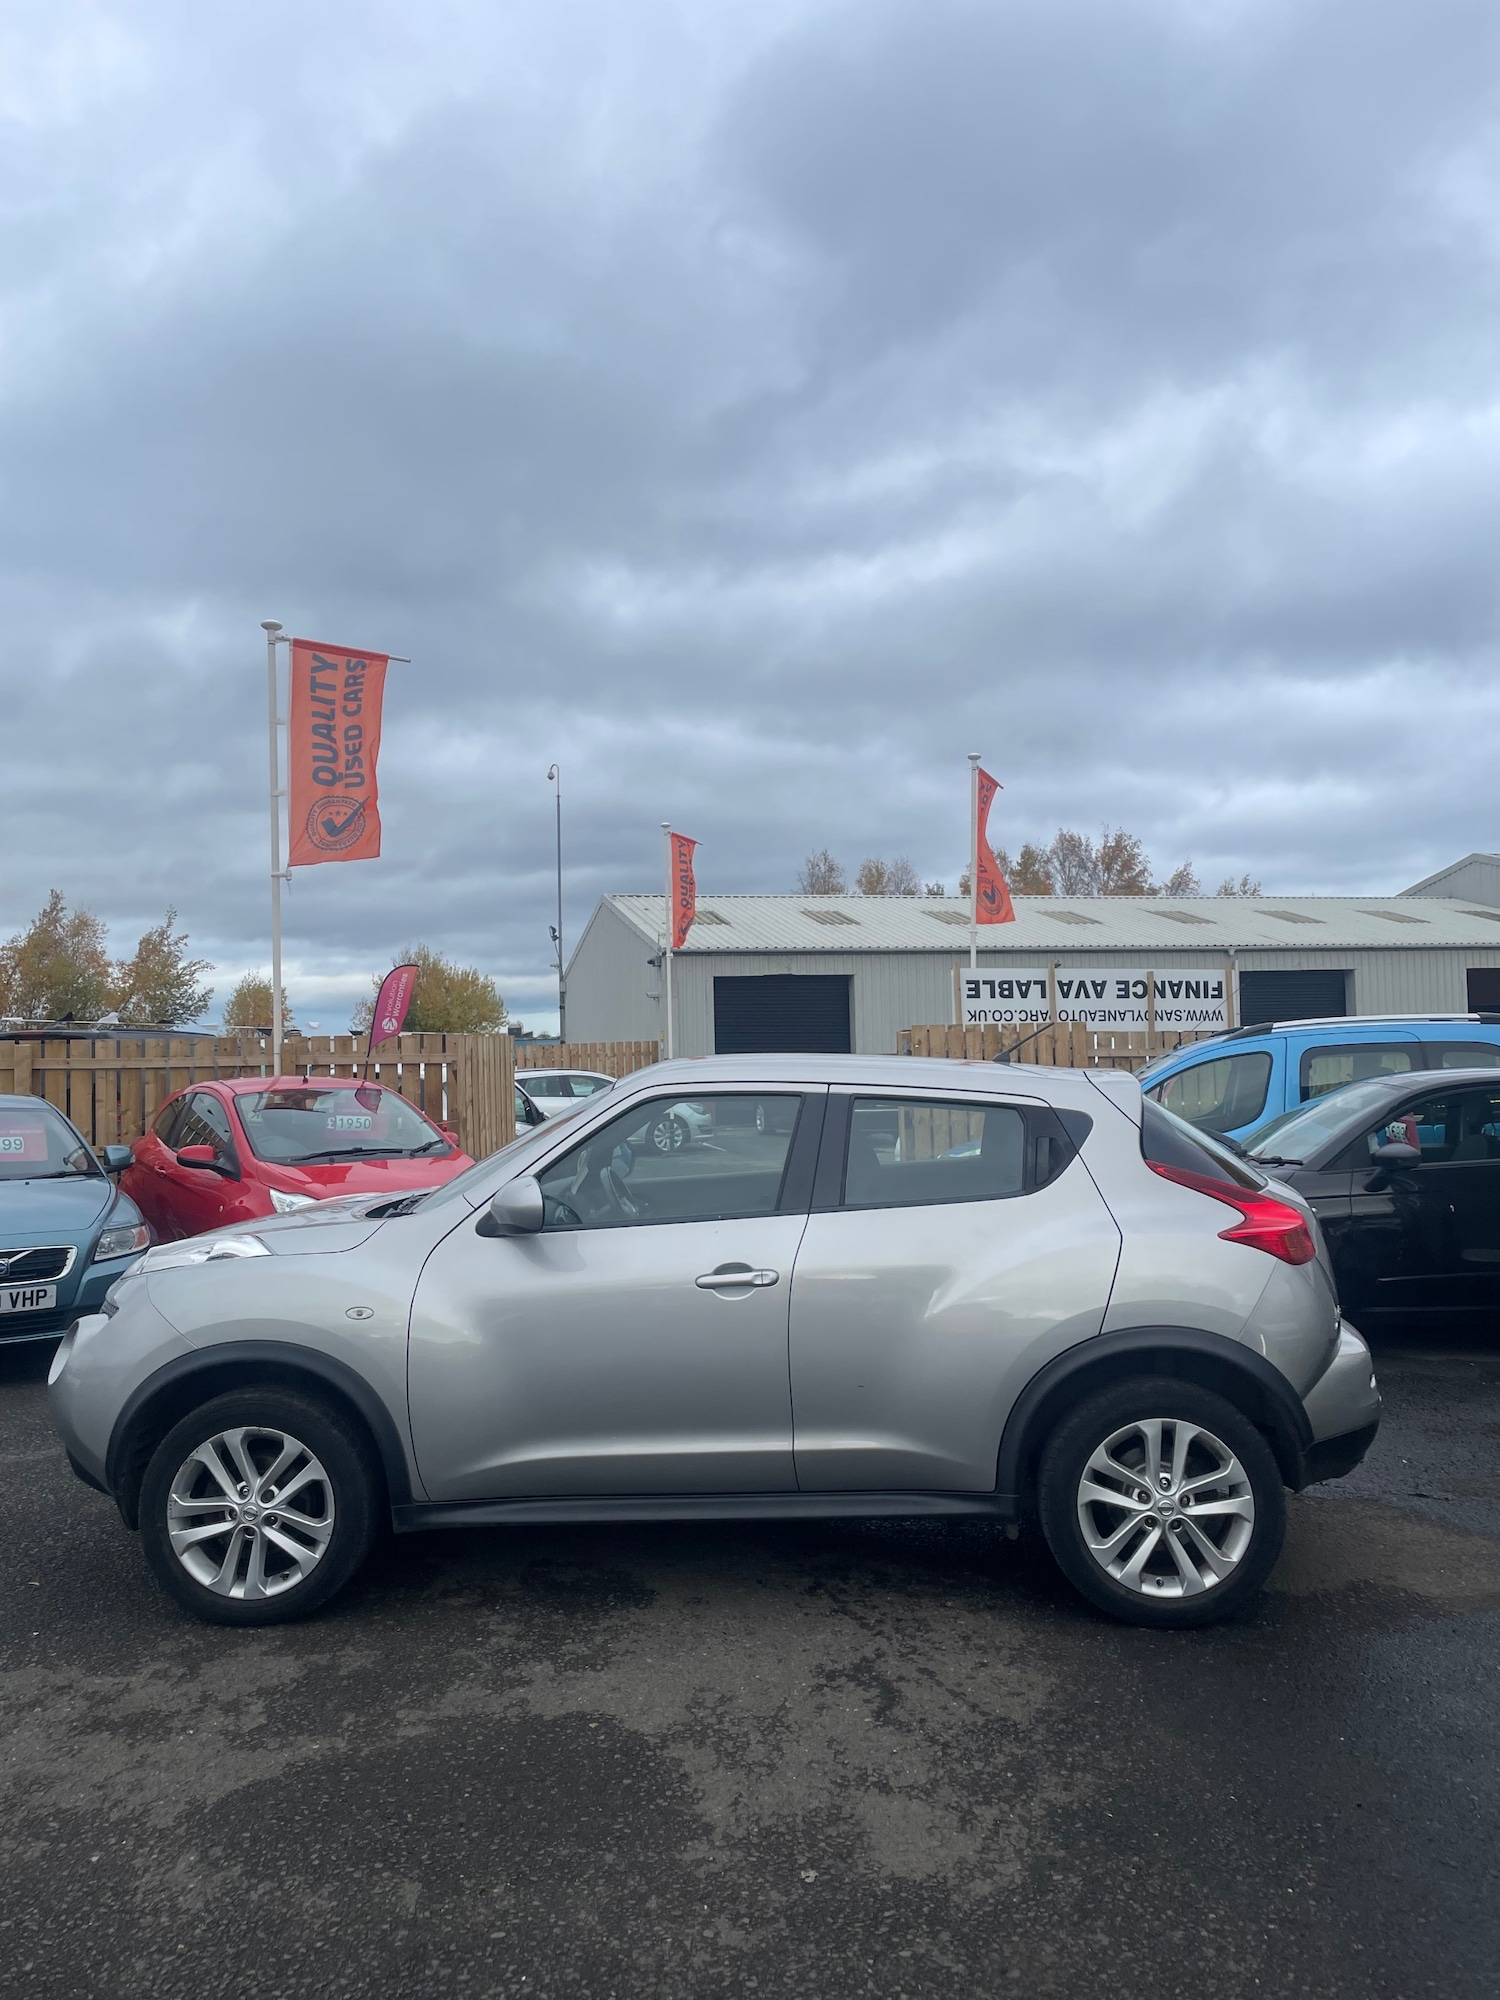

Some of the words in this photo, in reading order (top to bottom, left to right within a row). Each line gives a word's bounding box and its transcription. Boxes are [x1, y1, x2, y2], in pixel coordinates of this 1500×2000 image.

[343, 658, 367, 717] CARS
[310, 652, 344, 788] QUALITY
[343, 724, 366, 789] USED
[678, 839, 690, 909] QUALITY
[384, 980, 398, 1016] Evolution
[392, 973, 408, 1017] Warranties
[965, 979, 1108, 999] AVALABLE
[1115, 979, 1223, 999] FINANCE
[967, 1009, 1224, 1022] WWW.SANYLANEAUTOARC.CO.UK
[9, 1288, 48, 1309] VHP
